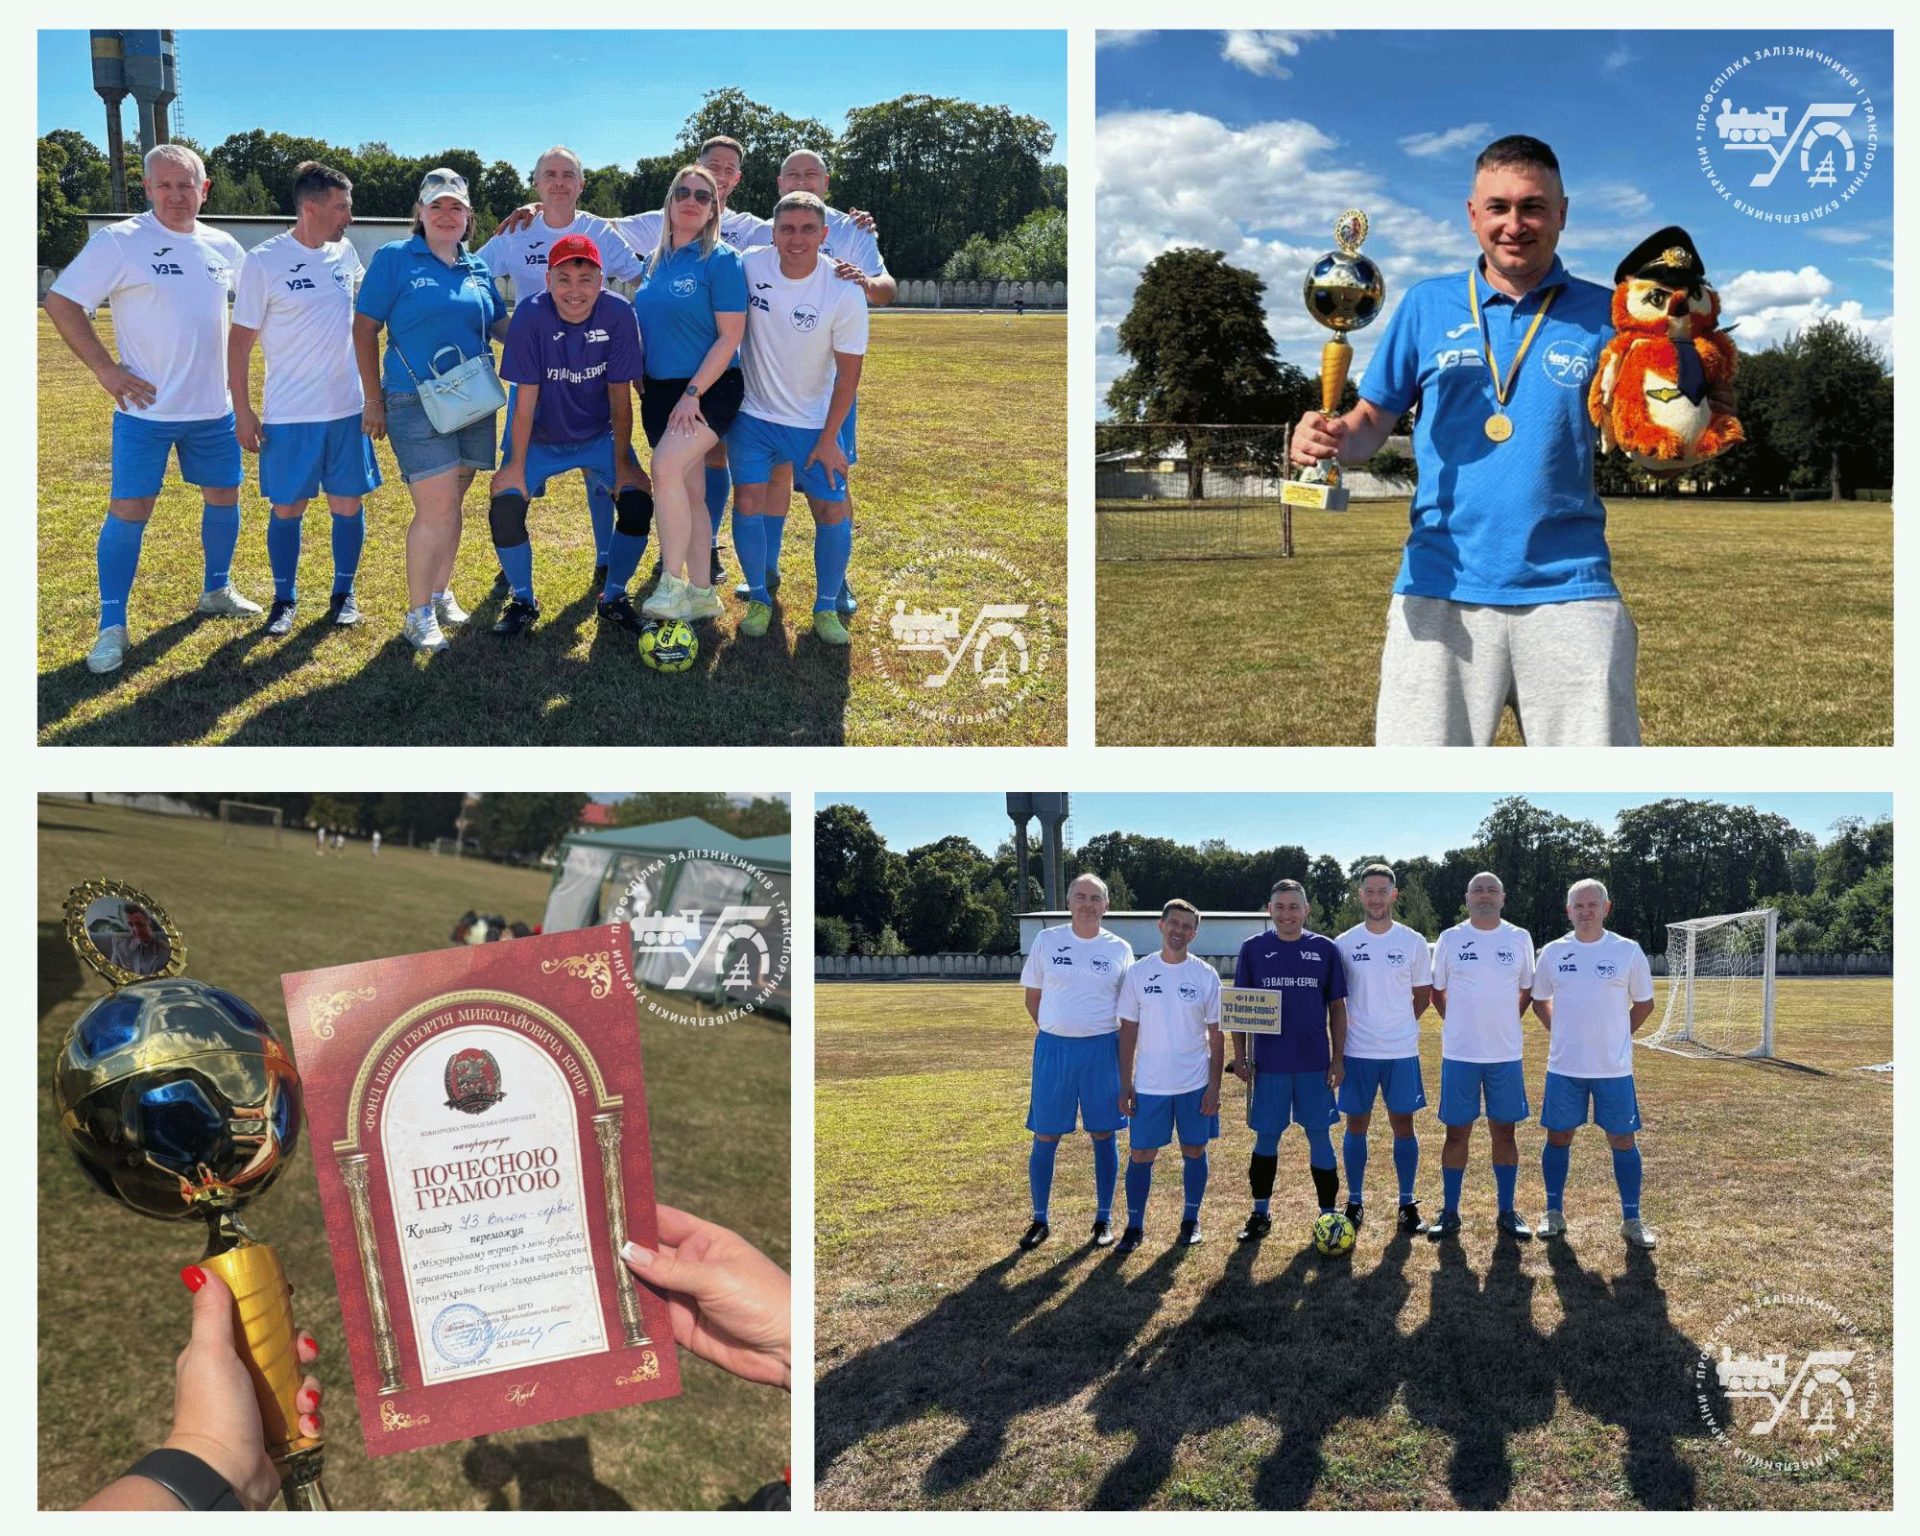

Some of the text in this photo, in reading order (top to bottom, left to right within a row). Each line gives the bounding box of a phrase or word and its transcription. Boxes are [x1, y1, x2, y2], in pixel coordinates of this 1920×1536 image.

[375, 1045, 405, 1085] ІМЕНІ
[403, 1012, 454, 1048] ГЕОРГІЯ
[458, 1008, 564, 1056] МИКОЛАЙОВИЧА
[411, 1145, 558, 1189] ПОЧЕСНОЮ
[414, 1168, 560, 1211] ГРАМОТОЮ
[406, 1222, 452, 1239] Команду
